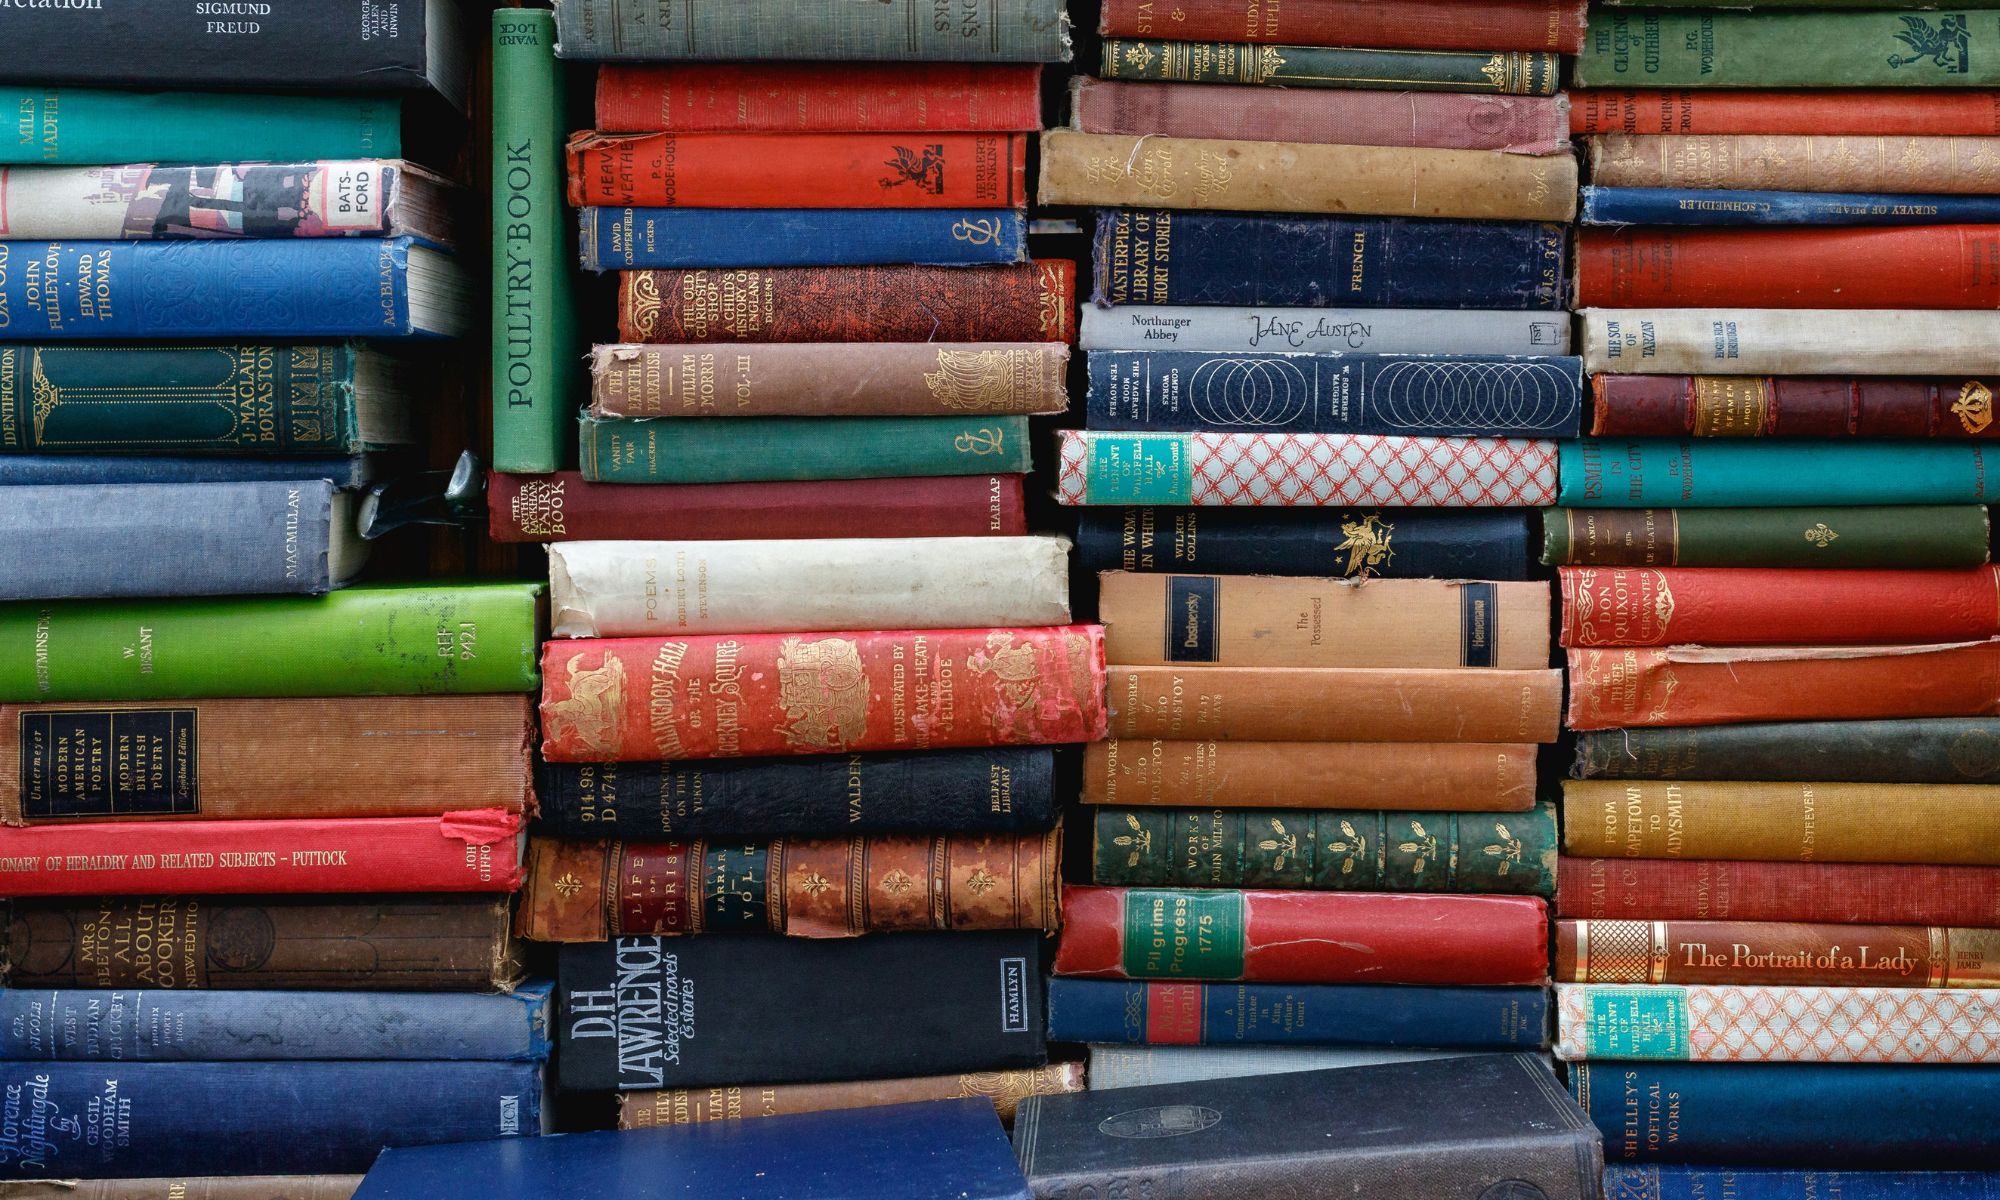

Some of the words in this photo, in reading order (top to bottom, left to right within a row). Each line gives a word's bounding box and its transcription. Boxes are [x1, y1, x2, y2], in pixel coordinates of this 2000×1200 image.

[196, 3, 271, 16] SIGMUND
[206, 21, 260, 34] FREUD
[362, 0, 370, 41] GEORGE
[372, 4, 380, 36] ALLEN
[390, 3, 399, 38] UNWIN
[500, 24, 537, 33] LOCK
[499, 36, 539, 45] WARD
[1218, 43, 1226, 75] RUPERT
[1595, 30, 1610, 54] THE
[1686, 30, 1698, 51] P.G.
[20, 98, 34, 144] MILES
[652, 155, 662, 179] P.G.
[665, 133, 676, 206] WODEHOUSE
[976, 139, 986, 200] HERBERT
[987, 138, 998, 200] JENKINS
[339, 171, 351, 213] BATS-
[356, 171, 369, 212] FORD
[1679, 198, 1756, 212] SCHMEIDLER
[1758, 202, 1771, 212] C.
[1871, 204, 1888, 215] OF
[1890, 204, 1938, 216] SURVEY
[613, 222, 621, 252] DAVID
[625, 208, 633, 266] COPPERFIELD
[647, 220, 655, 252] DICKENS
[1136, 213, 1150, 232] OF
[1155, 210, 1171, 262] STORIES
[27, 260, 41, 311] JOHN
[79, 254, 94, 317] EDWARD
[97, 250, 112, 320] THOMAS
[1134, 237, 1149, 301] LIBRARY
[1154, 266, 1168, 304] SHORT
[1352, 231, 1365, 292] FRENCH
[45, 242, 63, 330] FULLEYLOVE
[684, 274, 695, 301] OLD
[708, 282, 719, 321] SHOP
[749, 272, 759, 332] ENGLAND
[684, 306, 694, 330] THE
[1132, 315, 1191, 329] Northanger
[1144, 329, 1178, 342] Abbey
[1626, 333, 1637, 347] OF
[1640, 320, 1655, 358] TARZAN
[1, 348, 15, 446] IDENTIFICATION
[258, 346, 275, 441] BORASTON
[610, 369, 622, 395] THE
[647, 351, 660, 411] PARADISE
[683, 354, 695, 407] WILLIAM
[701, 353, 713, 407] MORRIS
[1109, 383, 1117, 417] NOVELS
[1162, 374, 1170, 405] WORKS
[1332, 374, 1340, 415] MAUGHAM
[612, 434, 620, 472] VANITY
[627, 441, 635, 464] FAIR
[648, 430, 656, 474] THACKERAY
[1100, 457, 1108, 479] THE
[1111, 444, 1119, 492] TENANT
[1133, 440, 1142, 496] WILDFELL
[1145, 454, 1153, 485] HALL
[1583, 441, 1602, 500] PSMITH
[1668, 456, 1679, 477] P.G.
[529, 480, 538, 534] RACKHAM
[538, 479, 550, 535] FAIRY
[552, 480, 566, 535] BOOK
[990, 478, 1001, 531] HARRAP
[287, 490, 299, 578] MACMILLAN
[1176, 515, 1184, 559] WILKIE
[1187, 512, 1196, 562] COLLINS
[646, 558, 657, 620] POEMS
[1600, 586, 1611, 623] DON
[1615, 571, 1630, 638] QUIXOTE
[1640, 572, 1652, 639] CERVANTES
[460, 622, 475, 660] 942.1
[1184, 592, 1201, 648] Dostoevsky
[1297, 610, 1308, 632] The
[1311, 597, 1322, 648] Possessed
[1472, 600, 1484, 648] Heinemann
[893, 644, 903, 659] BY
[893, 663, 905, 743] ILLUSTRATED
[940, 658, 953, 731] JELLICOE
[1611, 661, 1624, 704] THREE
[1624, 650, 1638, 715] MUSKETEERS
[32, 730, 42, 800] Untermeyer
[58, 736, 68, 792] MODERN
[75, 728, 86, 800] AMERICAN
[92, 737, 102, 791] POETRY
[120, 735, 130, 791] MODERN
[137, 734, 147, 791] BRITISH
[153, 736, 163, 790] POETRY
[177, 728, 188, 756] Edition
[177, 758, 188, 798] Combined
[580, 766, 595, 823] 914.98
[693, 772, 702, 813] YUKON
[849, 755, 861, 823] WALDEN
[991, 764, 1000, 812] BELFAST
[1002, 767, 1011, 813] LIBRARY
[1151, 738, 1163, 803] TOLSTOY
[1187, 813, 1199, 869] WORKS
[1605, 800, 1617, 844] FROM
[1650, 814, 1661, 832] TO
[46, 857, 62, 871] OF
[66, 855, 128, 871] HERALDRY
[132, 854, 155, 870] AND
[160, 853, 214, 868] RELATED
[219, 851, 276, 867] SUBJECTS
[292, 850, 346, 866] PUTTOCK
[632, 857, 644, 914] LIFE
[1590, 858, 1605, 918] STALKY
[82, 923, 96, 962] MRS
[135, 900, 156, 983] ABOUT
[1147, 898, 1165, 971] Pilgrims
[1170, 898, 1187, 973] Progress
[1199, 915, 1213, 954] 1775
[1957, 951, 1985, 960] HENRY
[665, 952, 678, 1000] novels
[1680, 943, 1728, 967] The
[1732, 943, 1814, 969] Portrait
[1816, 945, 1840, 969] of
[1841, 954, 1855, 969] a
[1858, 946, 1919, 976] Lady
[1956, 961, 1982, 970] JAMES
[570, 982, 617, 1039] D.H.
[616, 936, 663, 1090] LAWRENCE
[1009, 964, 1019, 1024] HAMLYN
[1160, 986, 1174, 1031] Mark
[1248, 995, 1257, 1029] Yankee
[1271, 1002, 1282, 1025] King
[1284, 992, 1293, 1032] Arthur's
[1296, 1001, 1305, 1027] Court
[30, 1001, 42, 1051] NICOLE
[65, 1007, 77, 1047] WEST
[87, 998, 100, 1055] INDIAN
[110, 993, 124, 1059] CRICKET
[663, 1001, 679, 1066] Selected
[1598, 1013, 1606, 1036] THE
[1608, 1001, 1618, 1049] TENANT
[1630, 997, 1639, 1053] WILDFELL
[1641, 1011, 1651, 1041] HALL
[20, 1074, 59, 1168] Nightingale
[87, 1096, 100, 1146] CECIL
[102, 1079, 118, 1162] WOODHAM
[118, 1098, 131, 1147] SMITH
[1625, 1071, 1638, 1158] SHELLEY'S
[1648, 1081, 1661, 1151] POETICAL
[1668, 1091, 1680, 1143] WORKS
